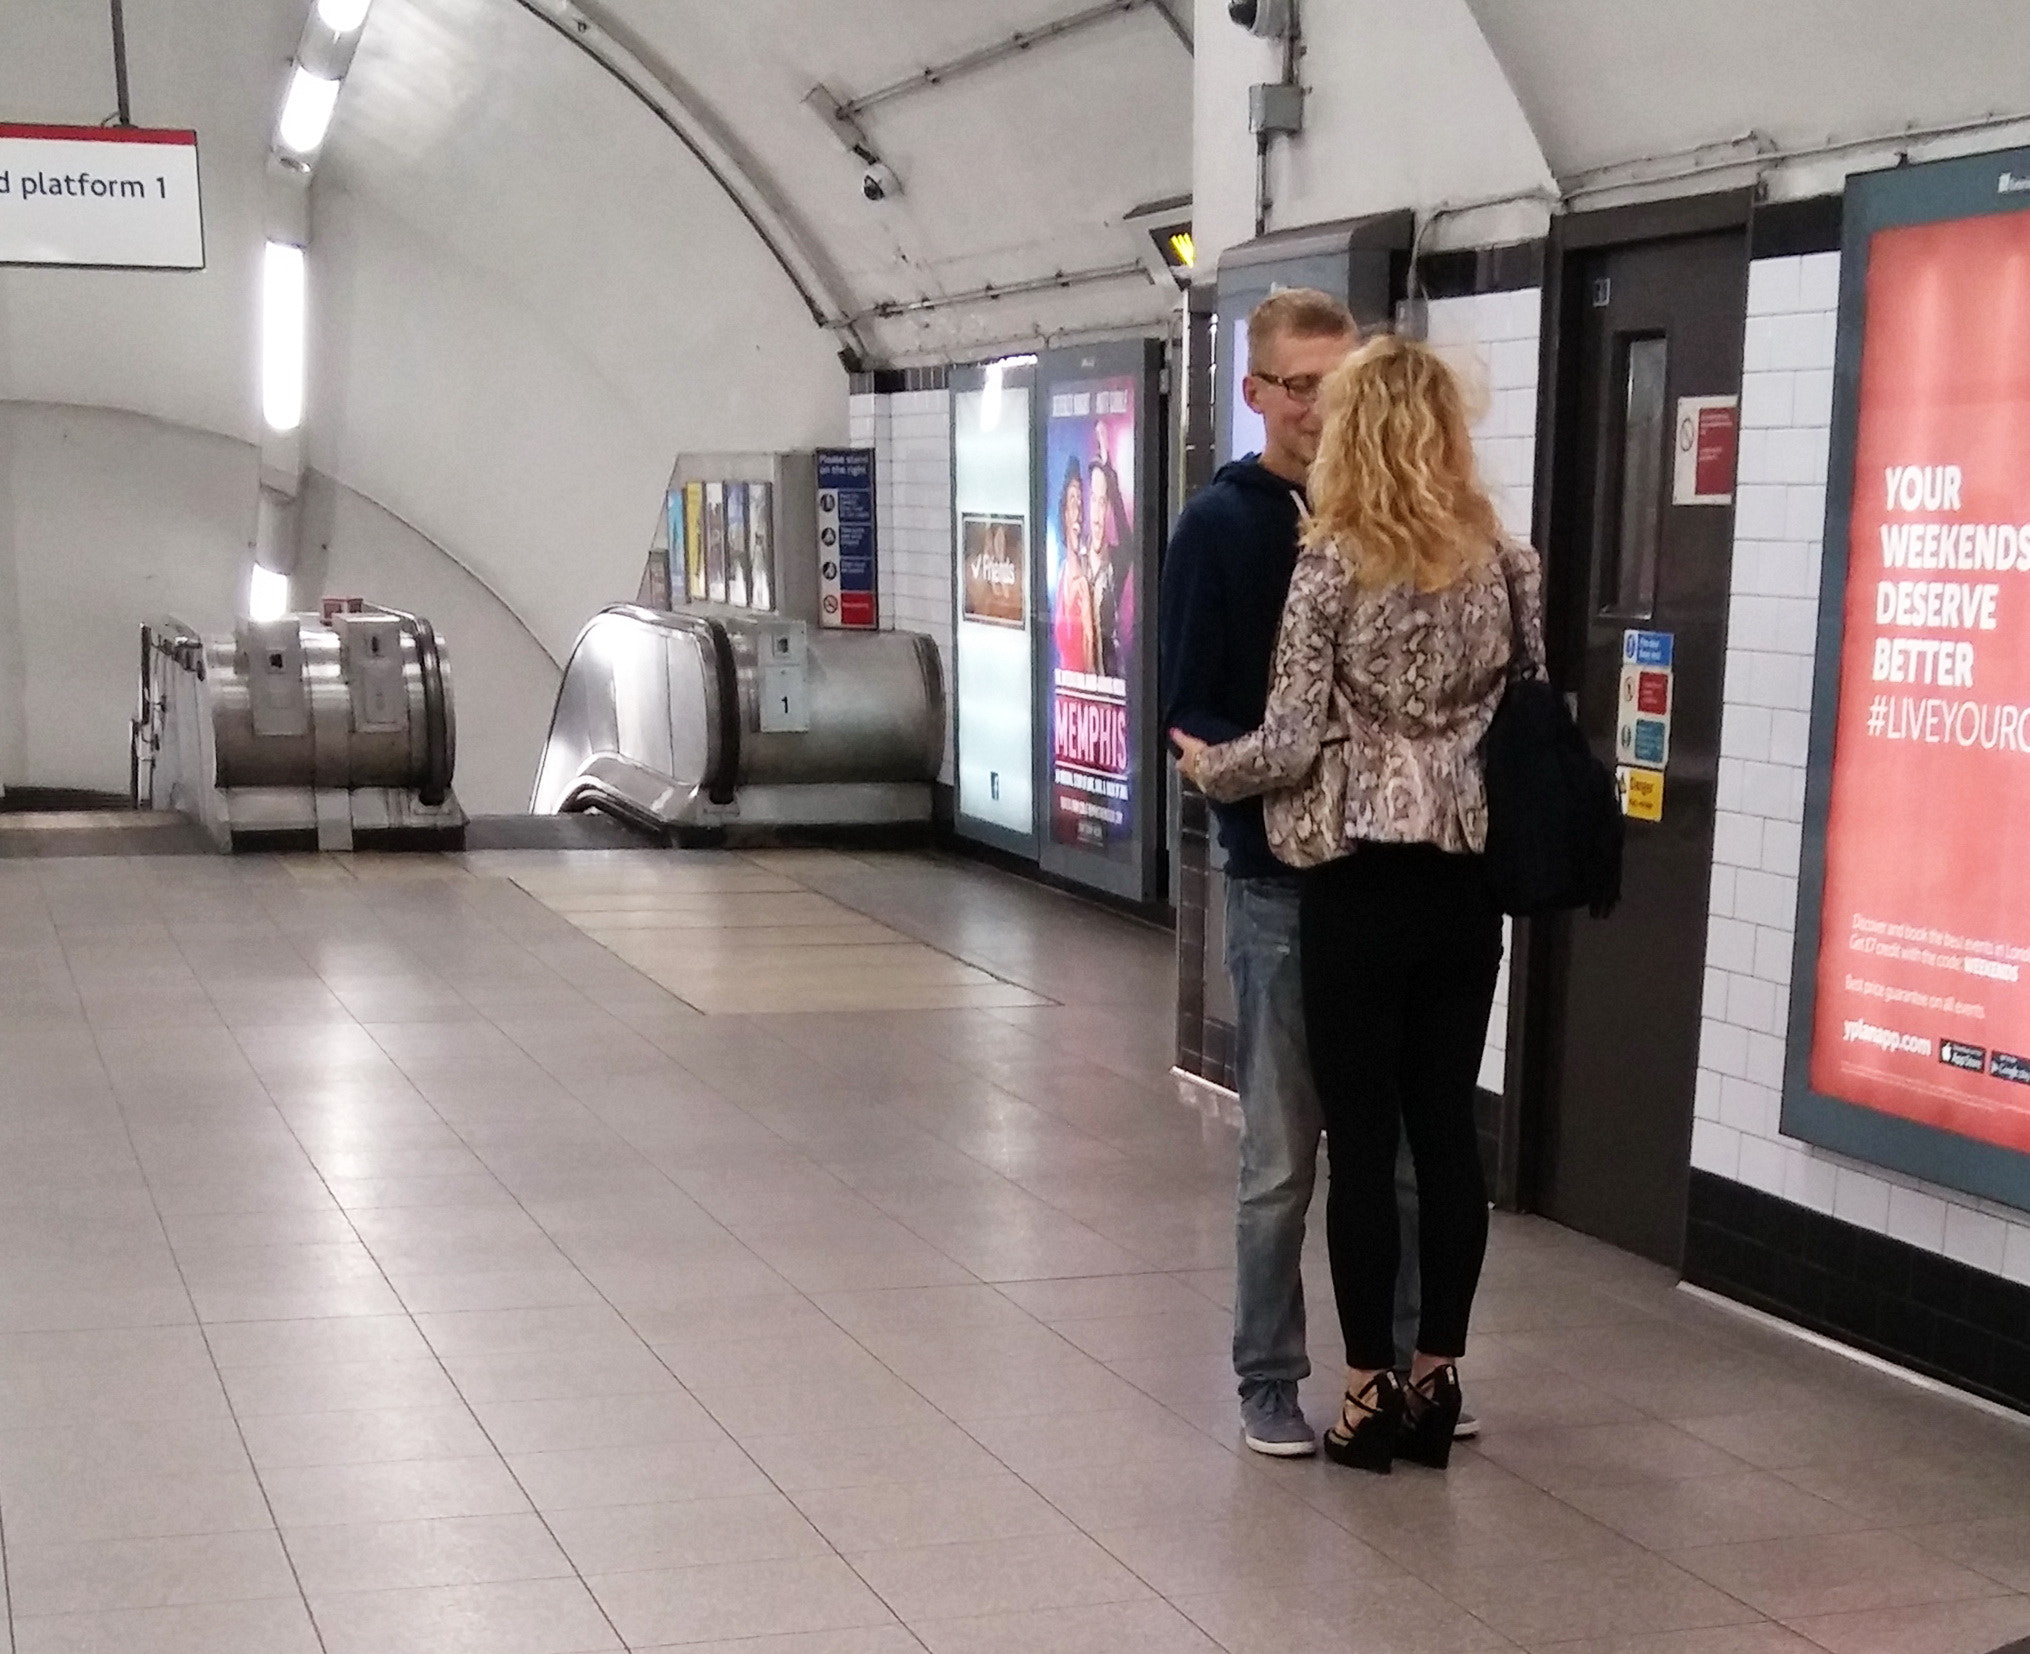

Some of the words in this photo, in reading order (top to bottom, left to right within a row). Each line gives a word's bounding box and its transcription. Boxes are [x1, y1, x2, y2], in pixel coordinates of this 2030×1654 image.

[21, 172, 145, 200] platform
[156, 176, 166, 199] 1
[1884, 464, 1962, 512] YOUR
[1880, 523, 2030, 572] WEEKENDS
[1875, 580, 1999, 631] DESERVE
[1872, 636, 1974, 688] BETTER
[781, 696, 789, 714] 1
[1055, 700, 1127, 770] MEMPHIS
[1842, 1017, 1932, 1057] yplanapp.com
